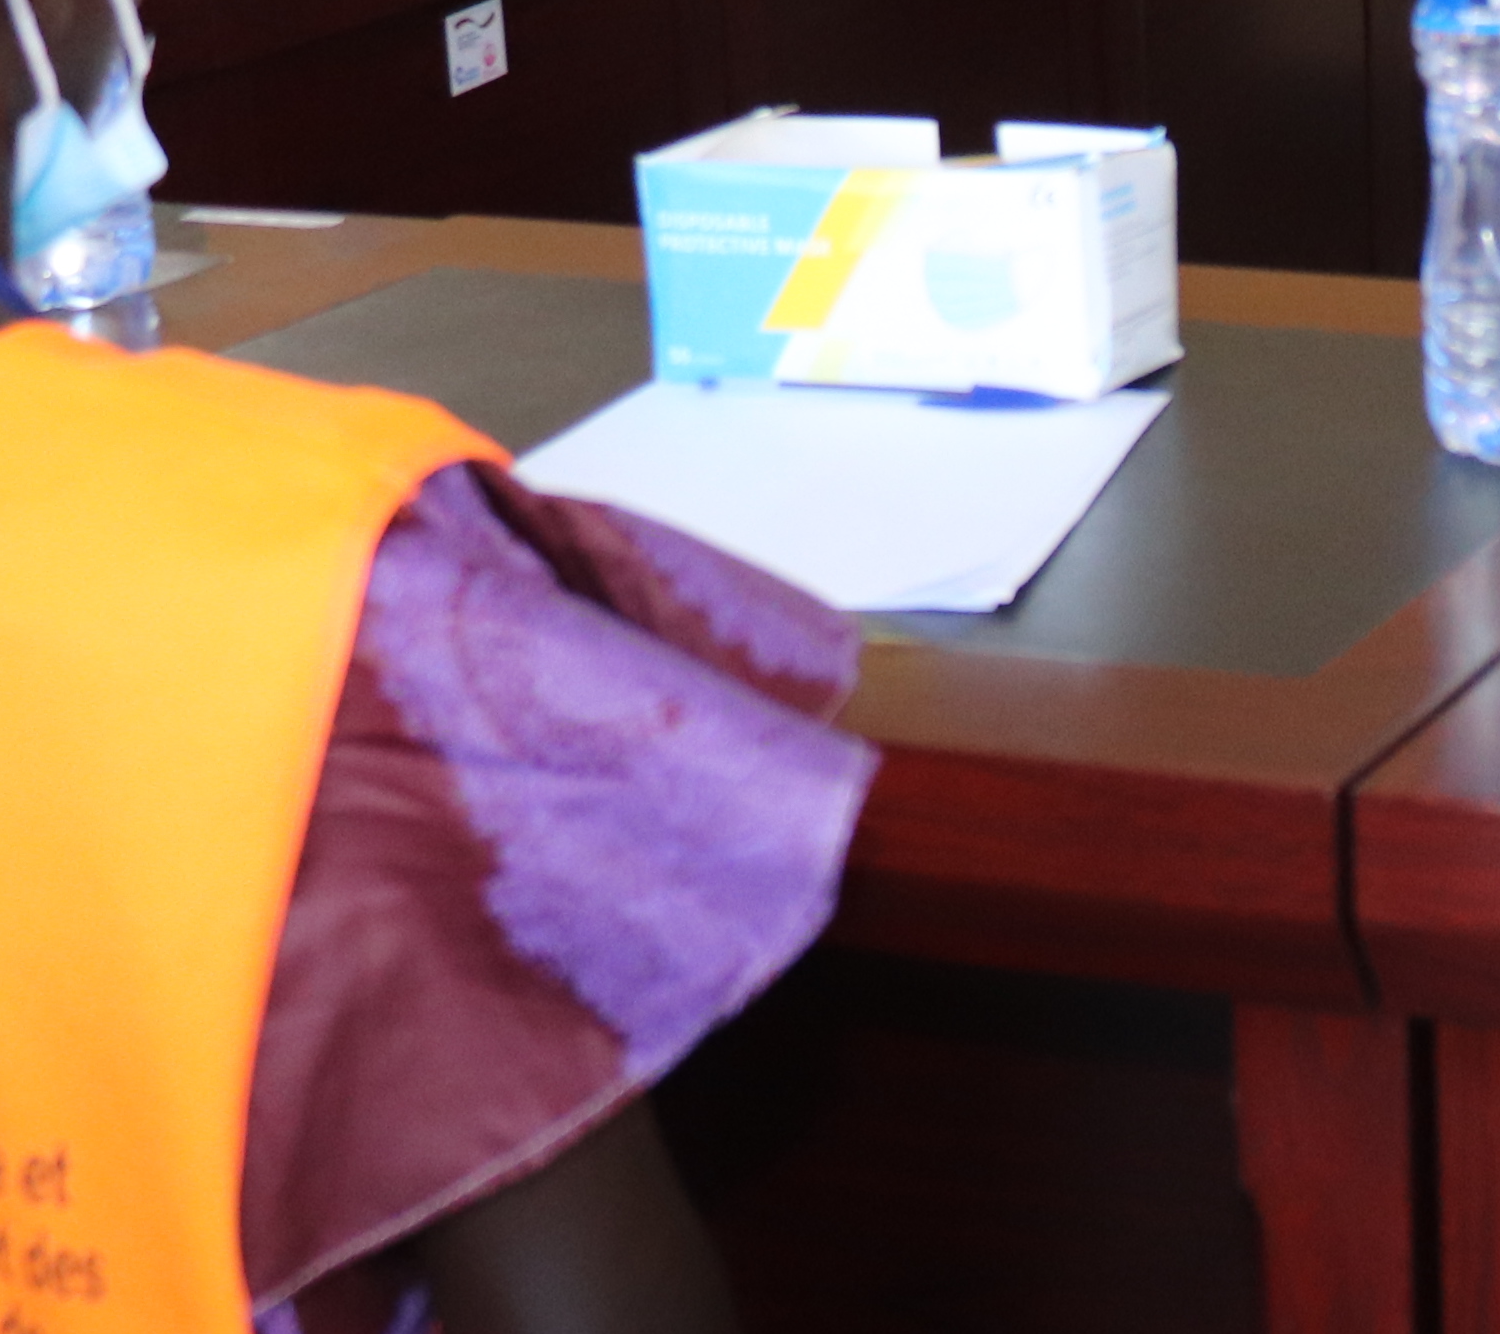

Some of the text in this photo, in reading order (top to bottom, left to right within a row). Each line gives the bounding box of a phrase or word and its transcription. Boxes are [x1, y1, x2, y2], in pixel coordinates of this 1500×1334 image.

[656, 209, 772, 234] DISPOSABLE
[657, 232, 773, 257] PROTECTIVE
[24, 1144, 69, 1205] et
